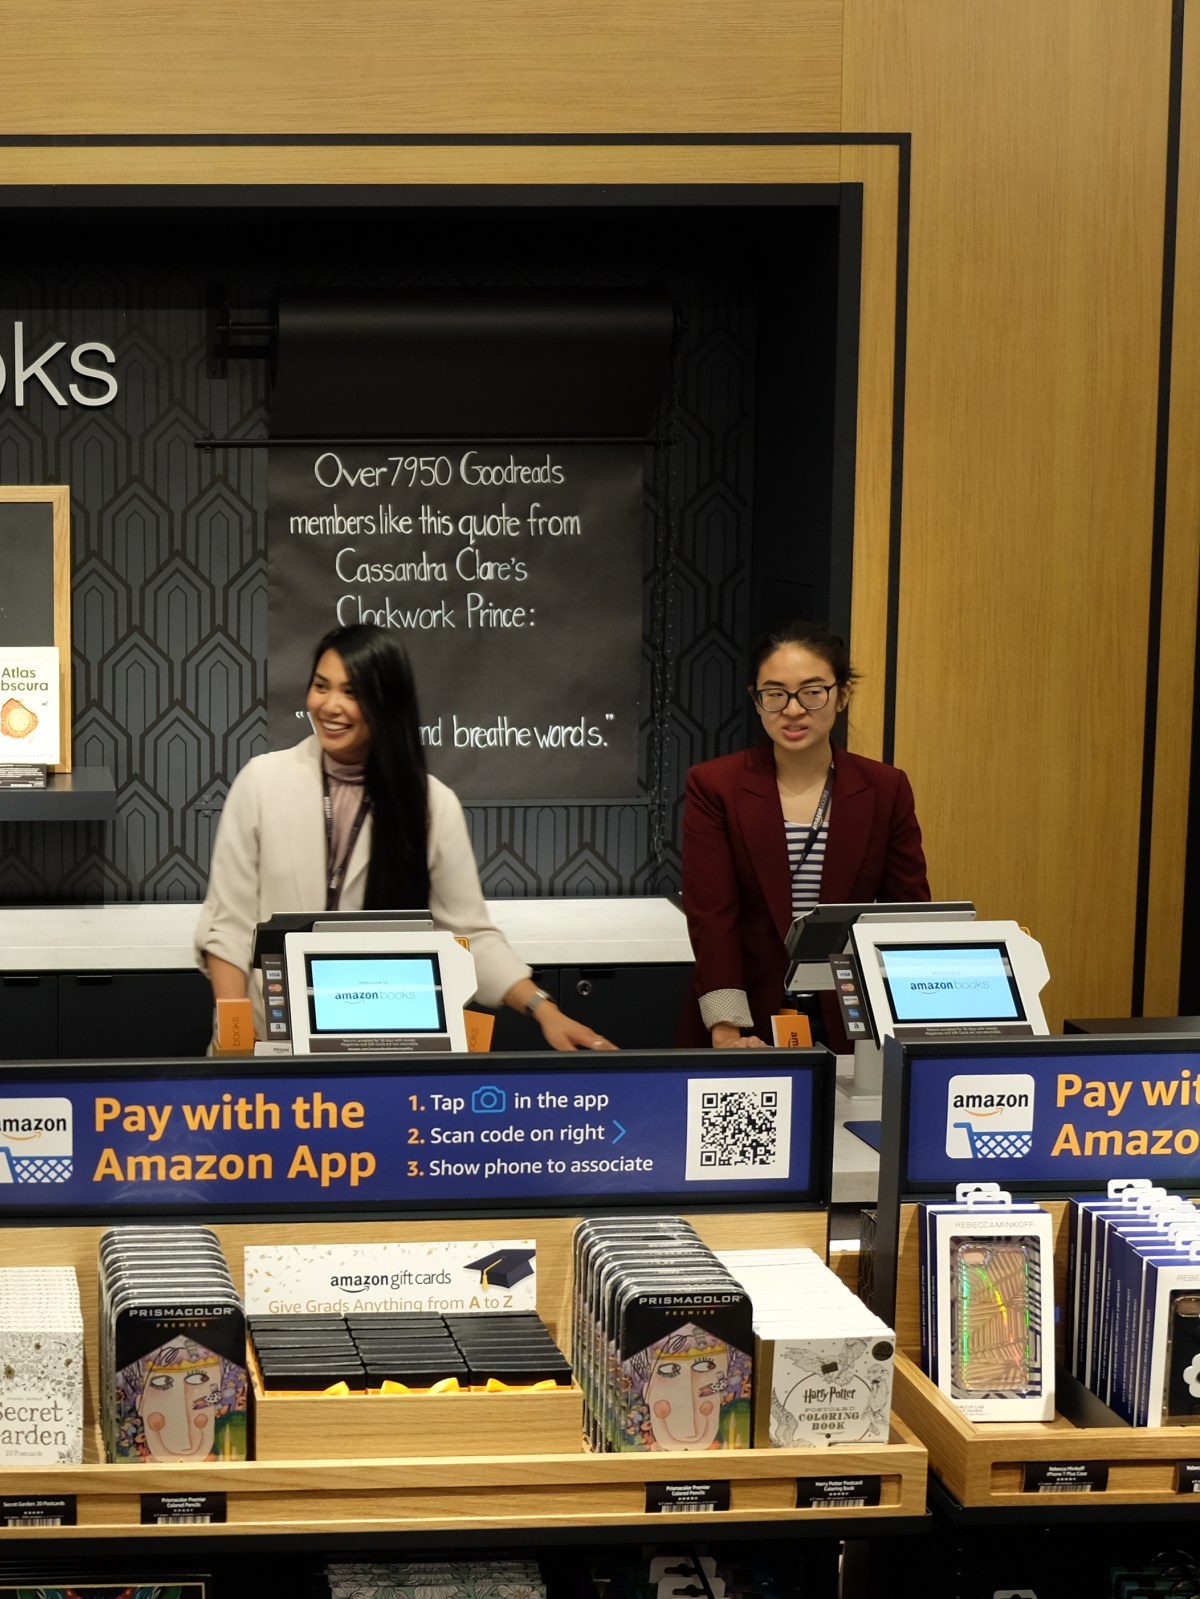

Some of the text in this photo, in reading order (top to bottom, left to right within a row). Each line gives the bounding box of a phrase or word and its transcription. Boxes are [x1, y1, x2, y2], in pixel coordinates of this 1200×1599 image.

[314, 451, 564, 488] Over 7950 Goodreads
[290, 503, 581, 544] members like this quote from
[335, 548, 527, 583] Cassandra Clare's
[337, 592, 534, 628] Clockwork Prince:
[1, 667, 36, 678] Atlas
[418, 717, 442, 746] nd
[453, 715, 531, 748] breathe
[335, 990, 415, 1000] amazon books
[910, 980, 989, 991] amazon books
[409, 1092, 609, 1114] 1. Tap in the app
[953, 1094, 1028, 1108] amazon
[1056, 1074, 1132, 1117] Pay
[95, 1092, 365, 1141] Pay with the
[407, 1124, 605, 1144] 2. Scan code on right
[1051, 1124, 1200, 1156] Amazo
[93, 1145, 377, 1187] Amazon App
[407, 1156, 653, 1178] 3. Show phone to associate
[330, 1269, 452, 1289] amazon gift cards
[269, 1295, 513, 1314] Give Grads Anything from A to Z
[639, 1295, 741, 1305] PRISMACOLOR
[129, 1307, 232, 1317] PRISMACOLOR
[804, 1387, 856, 1406] Harry Potter
[799, 1412, 860, 1421] COLORING
[811, 1421, 845, 1431] BOOK
